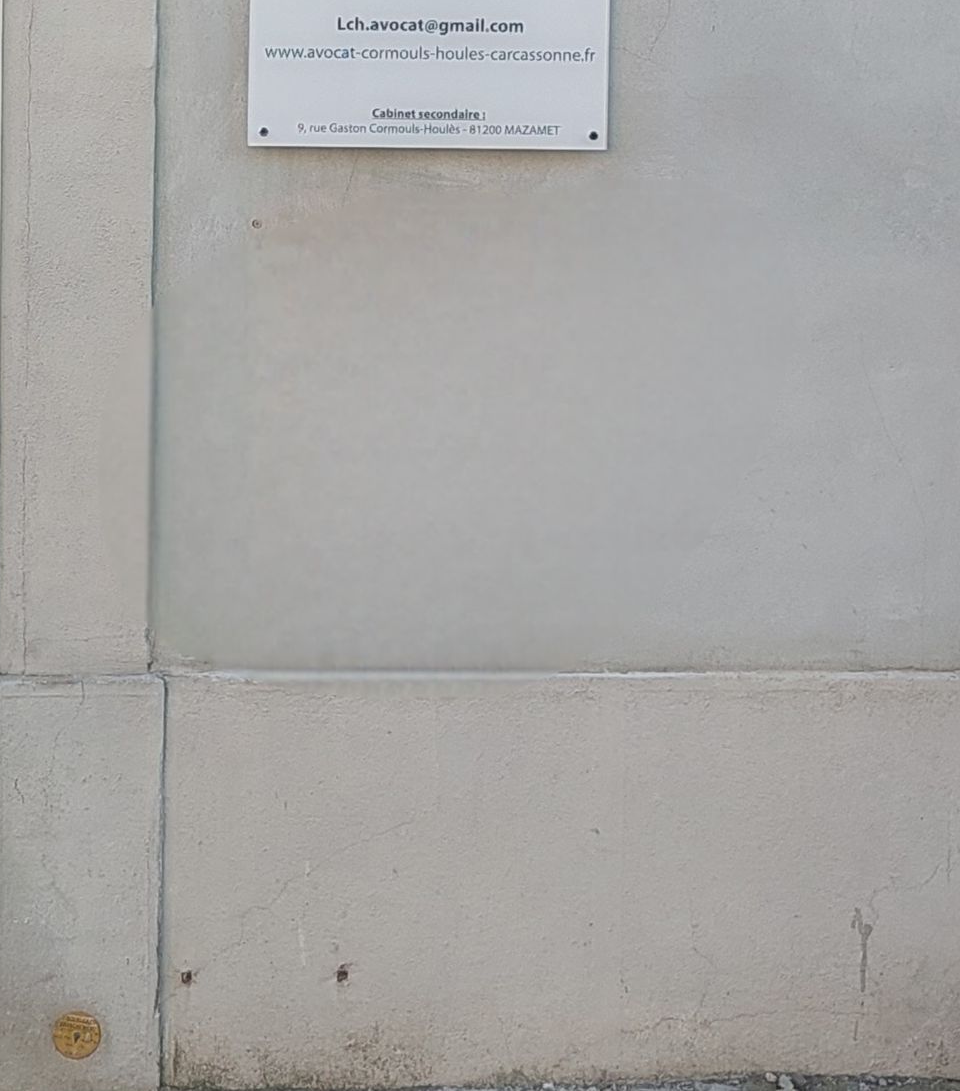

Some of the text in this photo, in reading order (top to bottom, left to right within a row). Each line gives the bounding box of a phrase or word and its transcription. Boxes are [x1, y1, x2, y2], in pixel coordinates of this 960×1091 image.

[337, 16, 524, 36] Lch.avocat@gmail.com
[265, 44, 596, 63] www.avocat-cormouls-houles-carcassonne.fr
[372, 108, 416, 120] Cabinet
[297, 123, 307, 134] 9,
[309, 124, 327, 133] rue
[329, 123, 367, 134] Gaston
[369, 123, 461, 135] Cormouls-Houlès
[469, 125, 502, 135] 81200
[504, 125, 561, 136] MAZAMET
